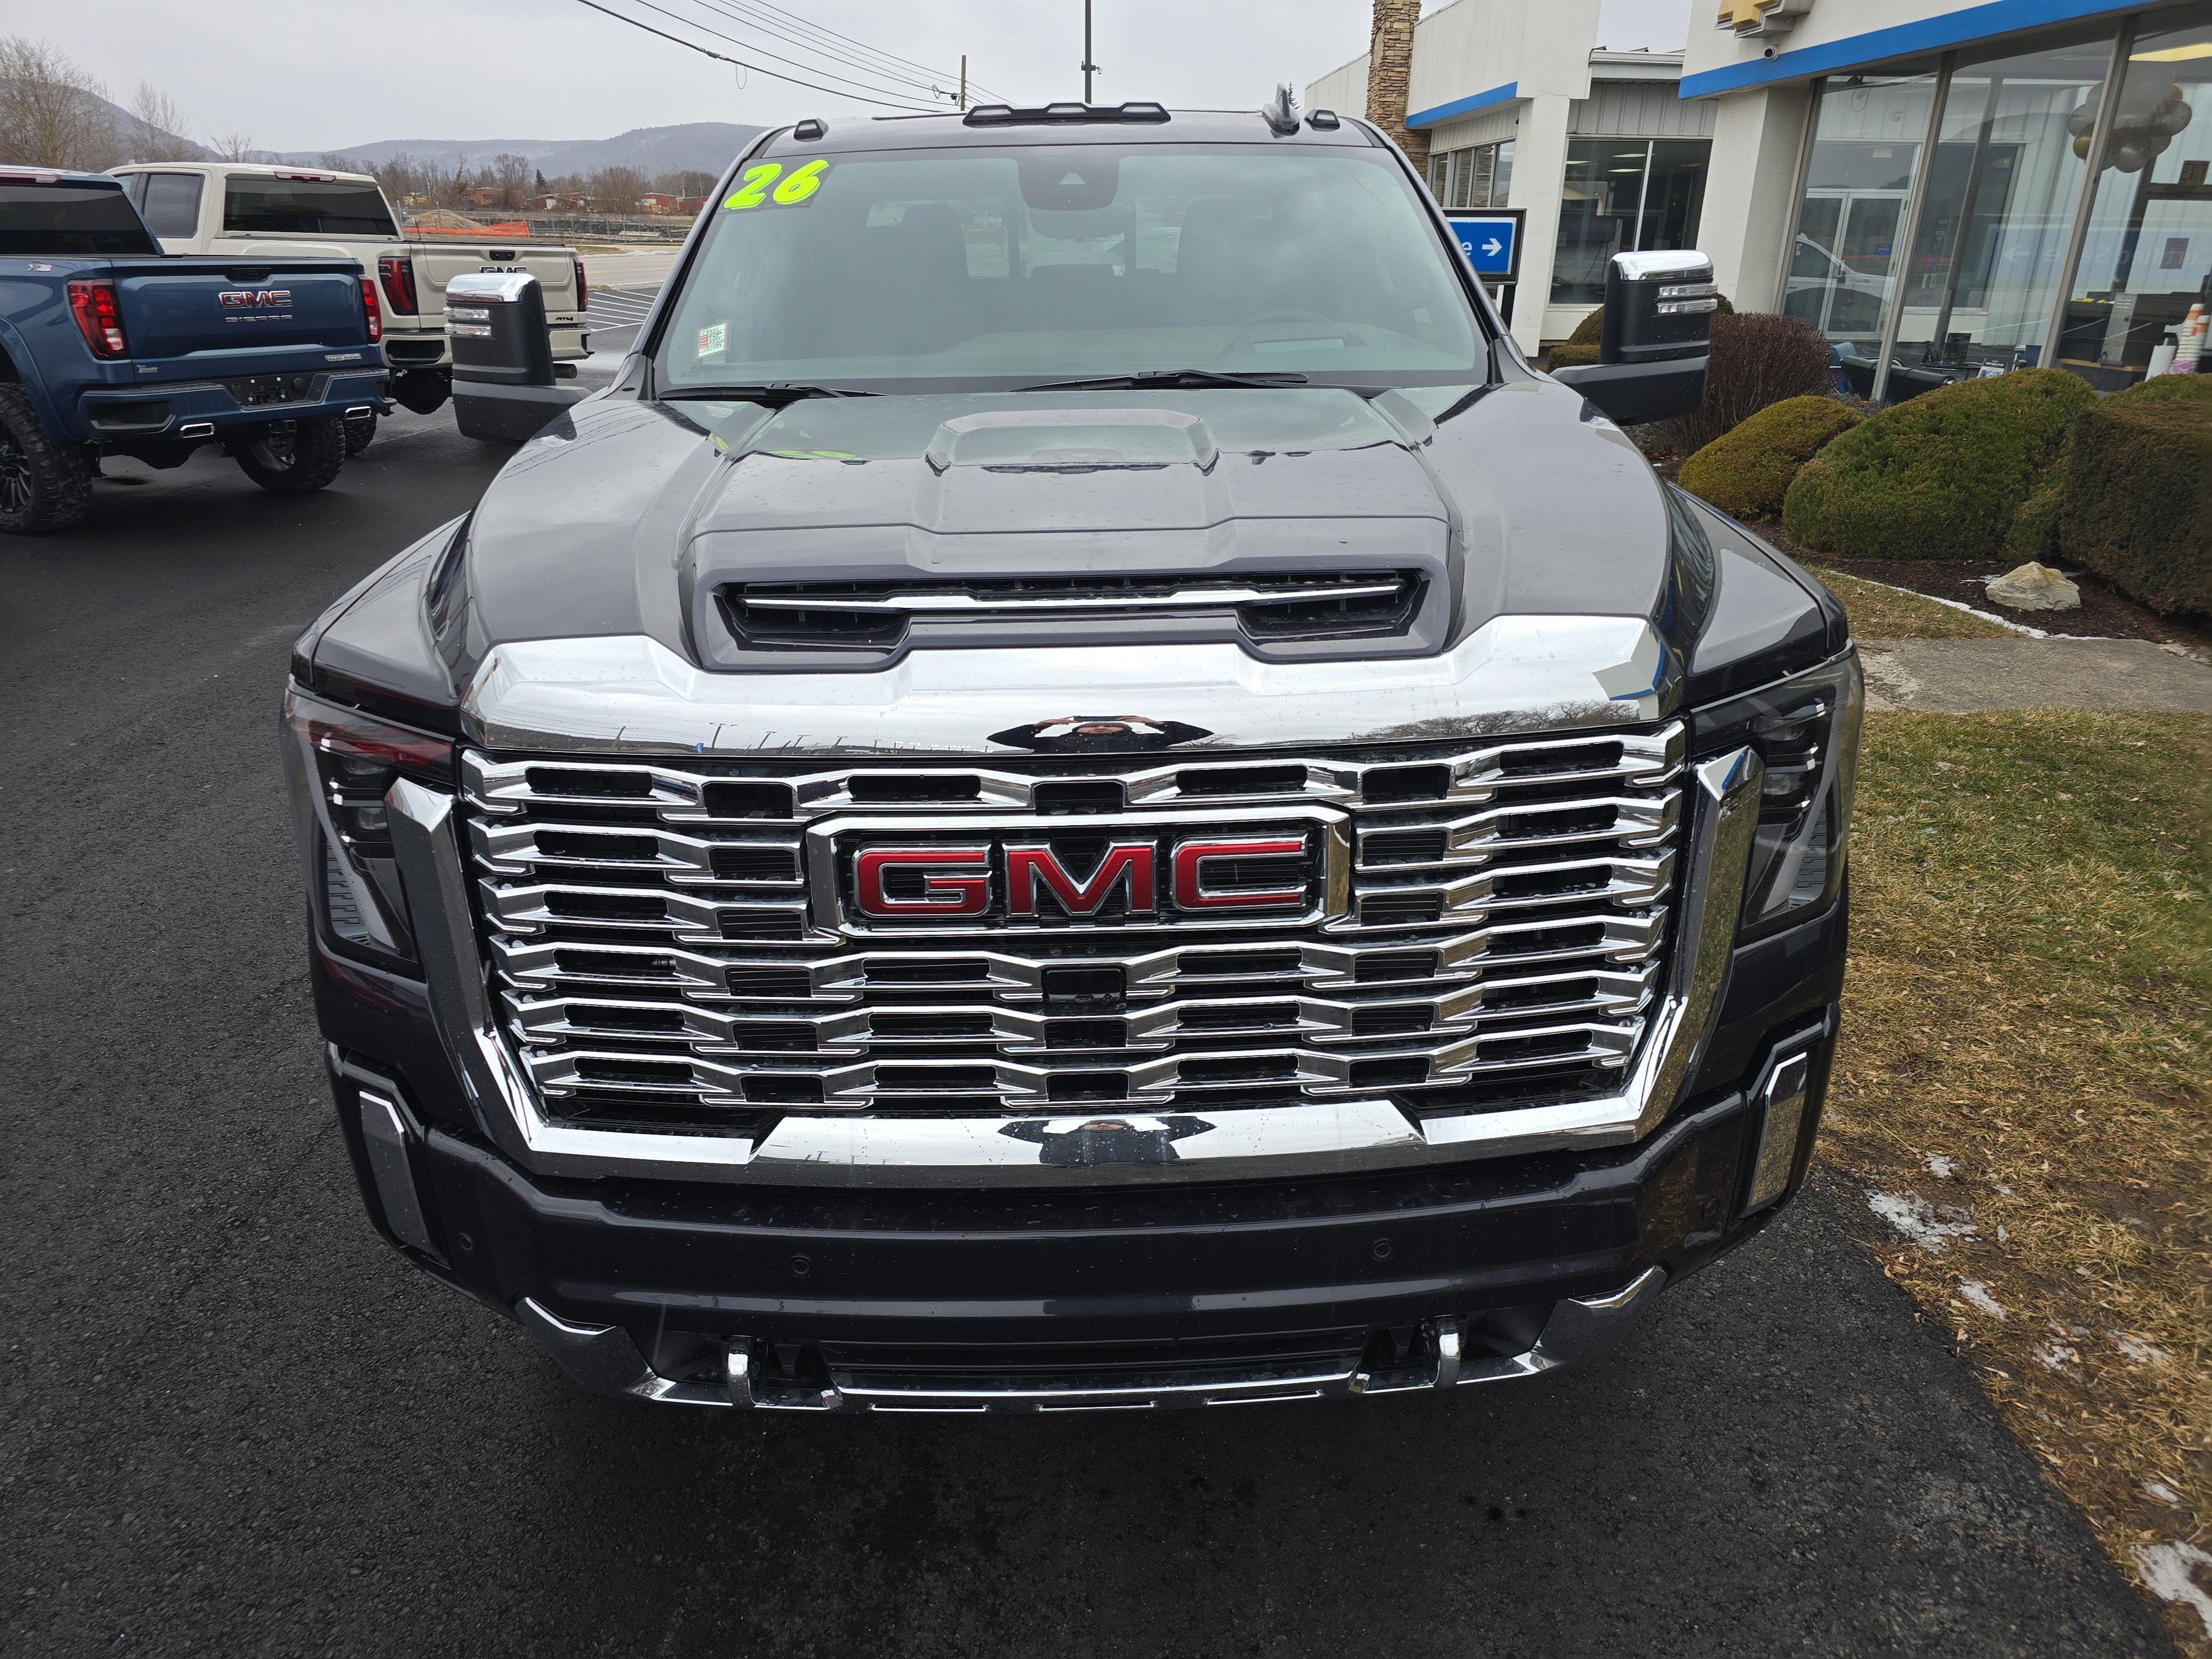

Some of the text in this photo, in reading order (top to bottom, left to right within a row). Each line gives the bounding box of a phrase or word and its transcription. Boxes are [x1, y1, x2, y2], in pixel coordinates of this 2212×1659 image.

[724, 159, 829, 210] 26
[218, 290, 293, 307] GMC
[853, 833, 1308, 918] GMC
